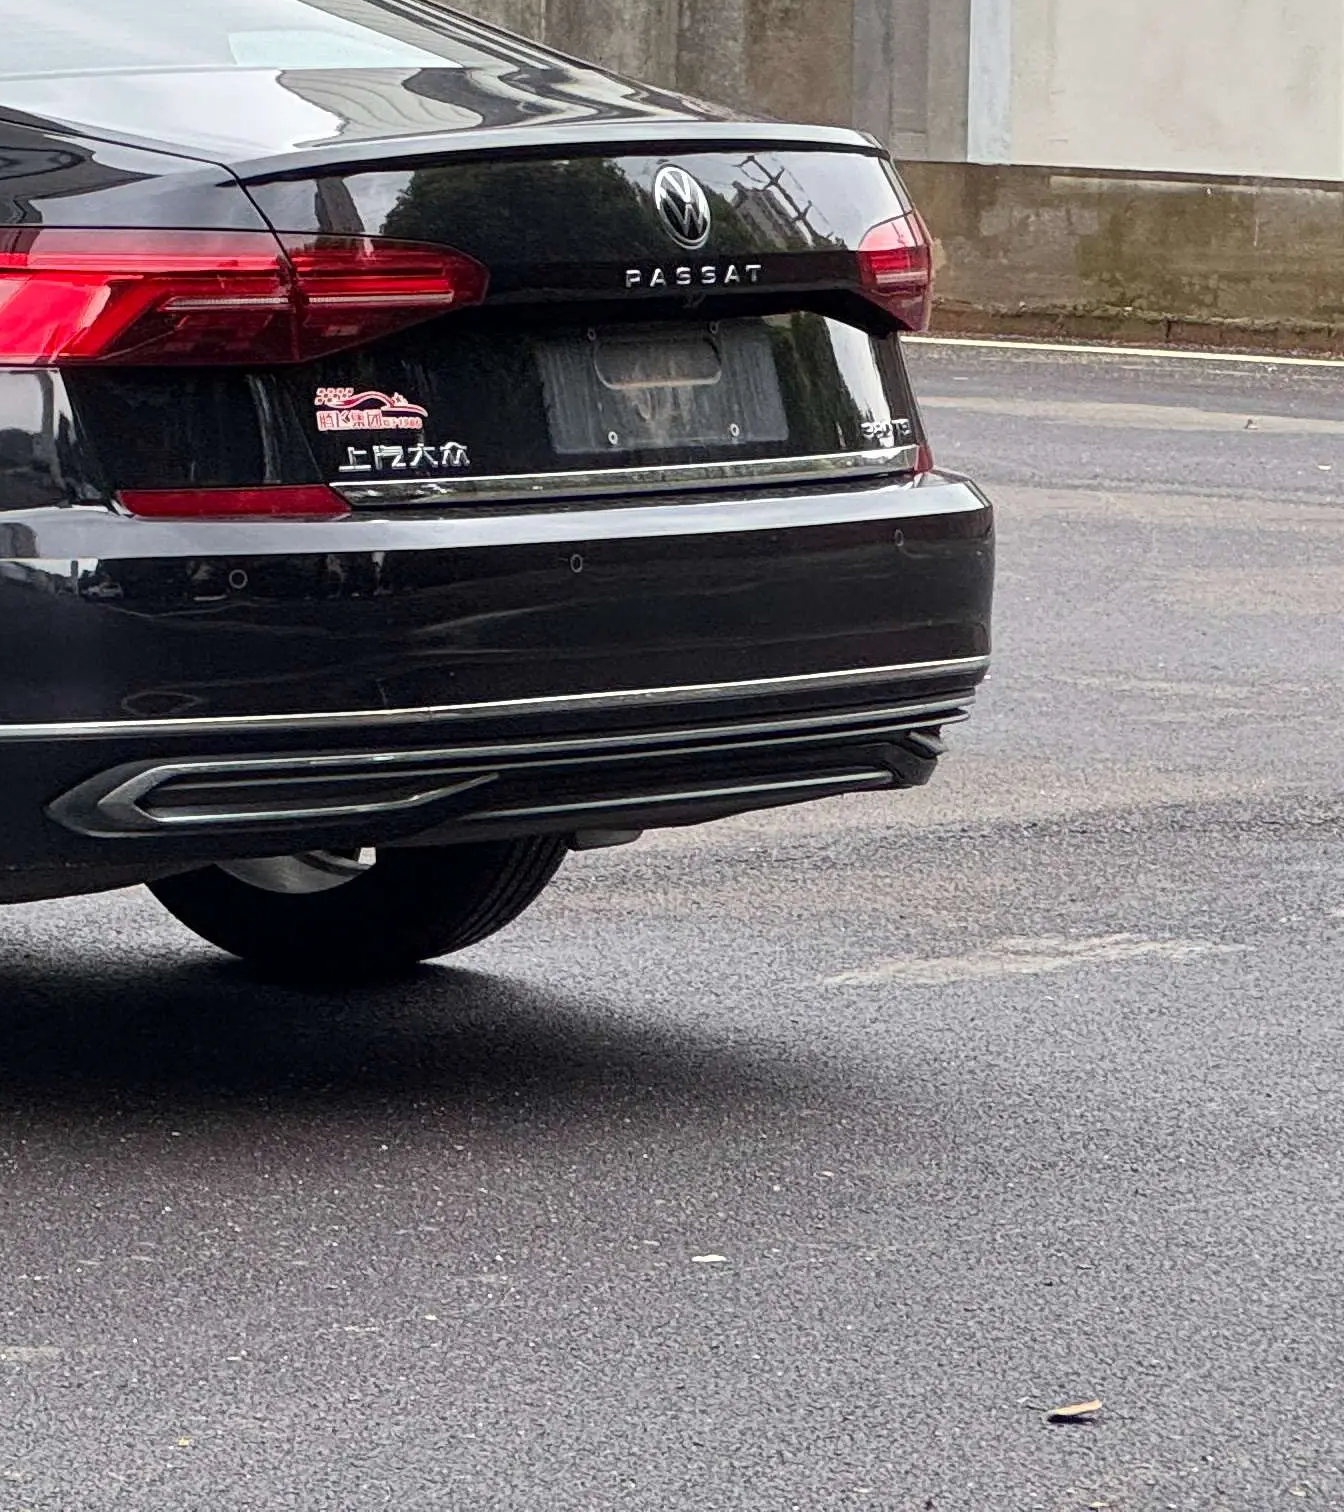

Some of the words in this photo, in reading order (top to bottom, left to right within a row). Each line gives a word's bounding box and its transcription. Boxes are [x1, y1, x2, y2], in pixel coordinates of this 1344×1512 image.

[655, 165, 710, 246] VW
[625, 264, 762, 288] PASSAT
[339, 441, 470, 472] 上汽大众
